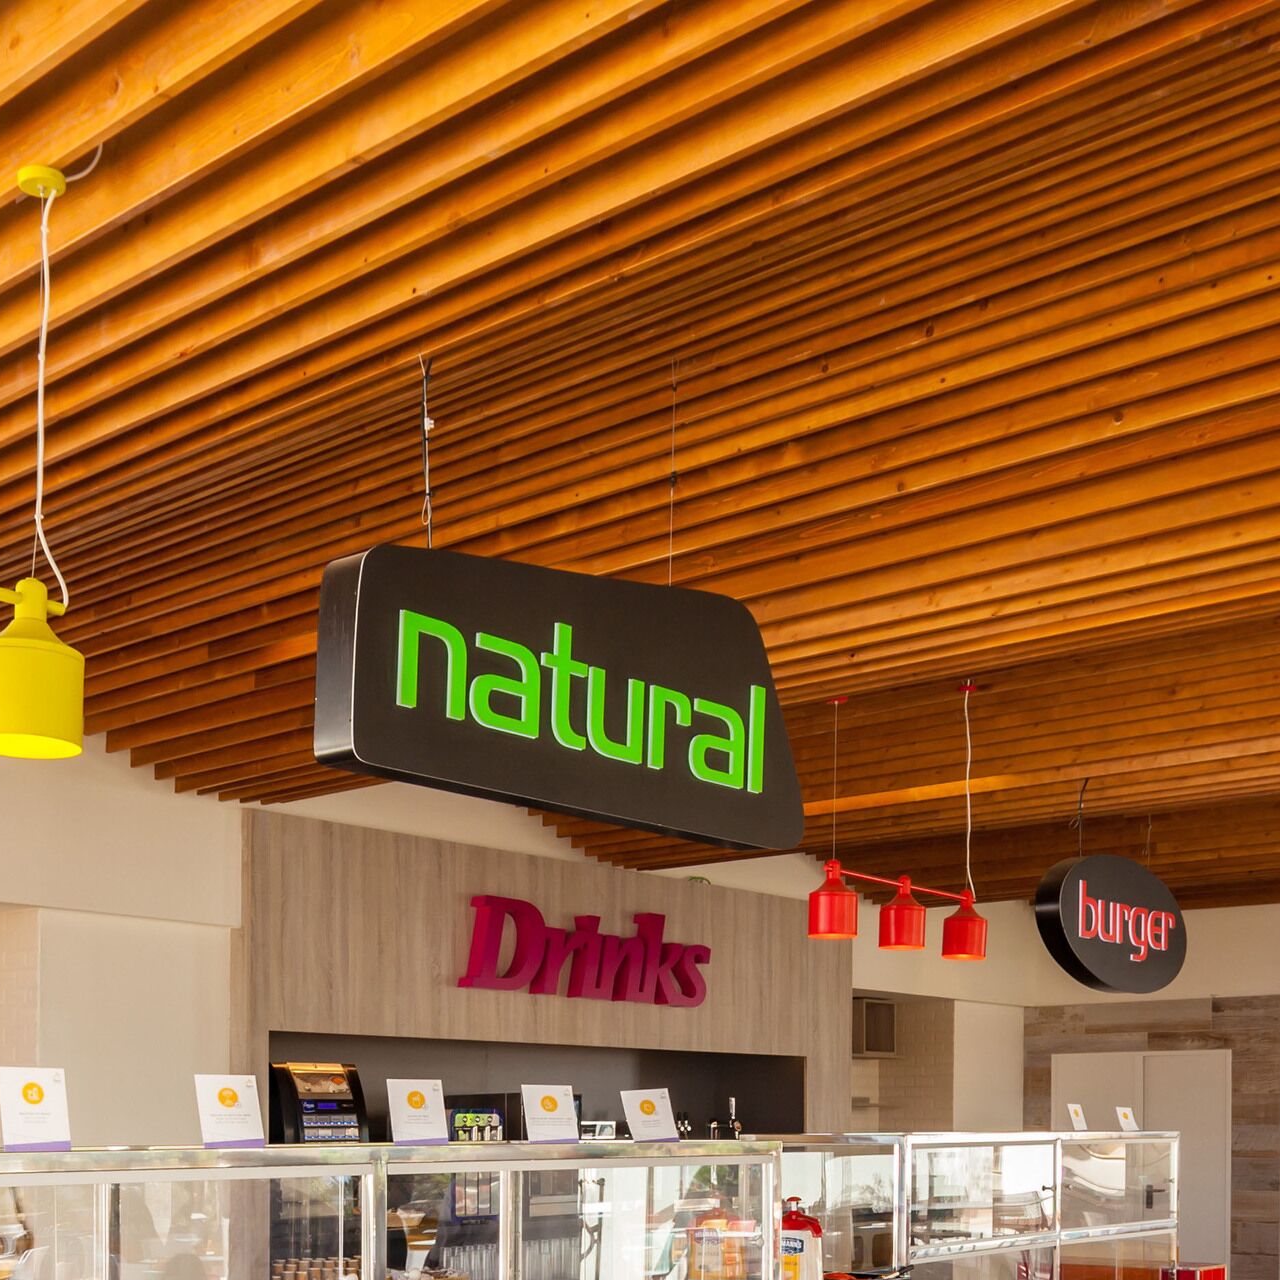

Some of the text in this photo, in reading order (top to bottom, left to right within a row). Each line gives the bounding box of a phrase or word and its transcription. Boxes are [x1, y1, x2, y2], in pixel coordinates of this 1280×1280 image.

[396, 609, 767, 794] natural
[457, 894, 712, 1008] Drinks
[1078, 879, 1176, 962] burger
